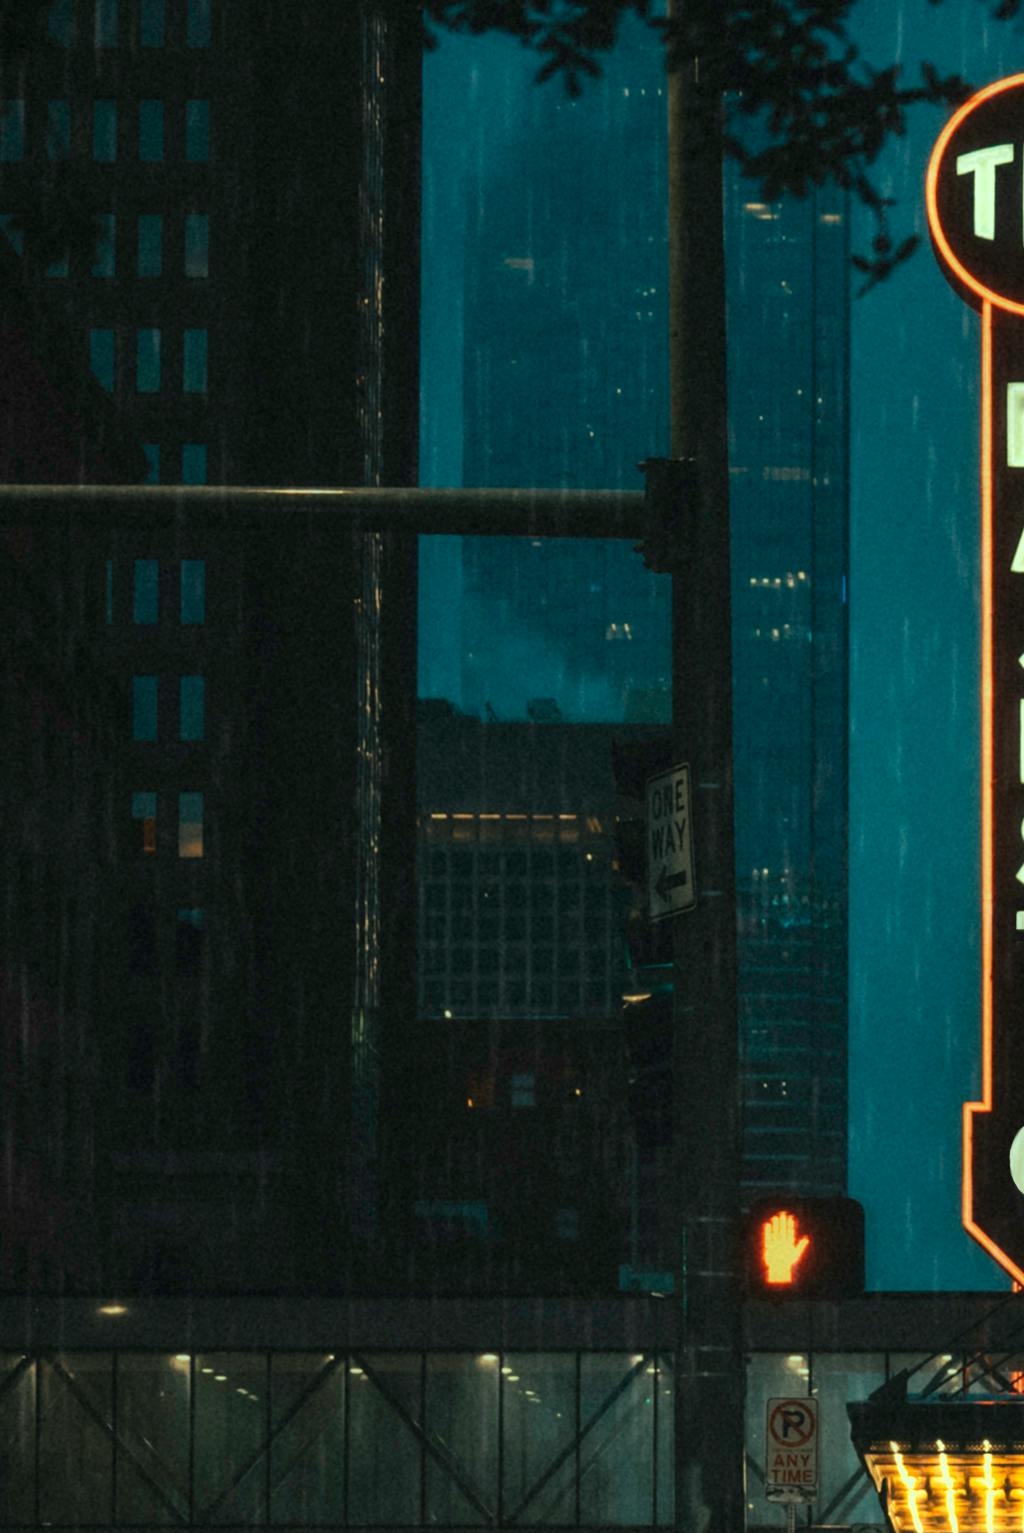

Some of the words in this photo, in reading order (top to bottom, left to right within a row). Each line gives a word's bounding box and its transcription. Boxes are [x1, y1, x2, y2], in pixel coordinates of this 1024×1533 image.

[652, 779, 686, 820] ONE
[651, 818, 686, 861] WAY
[774, 1454, 810, 1467] ANY
[771, 1469, 812, 1483] TIME
